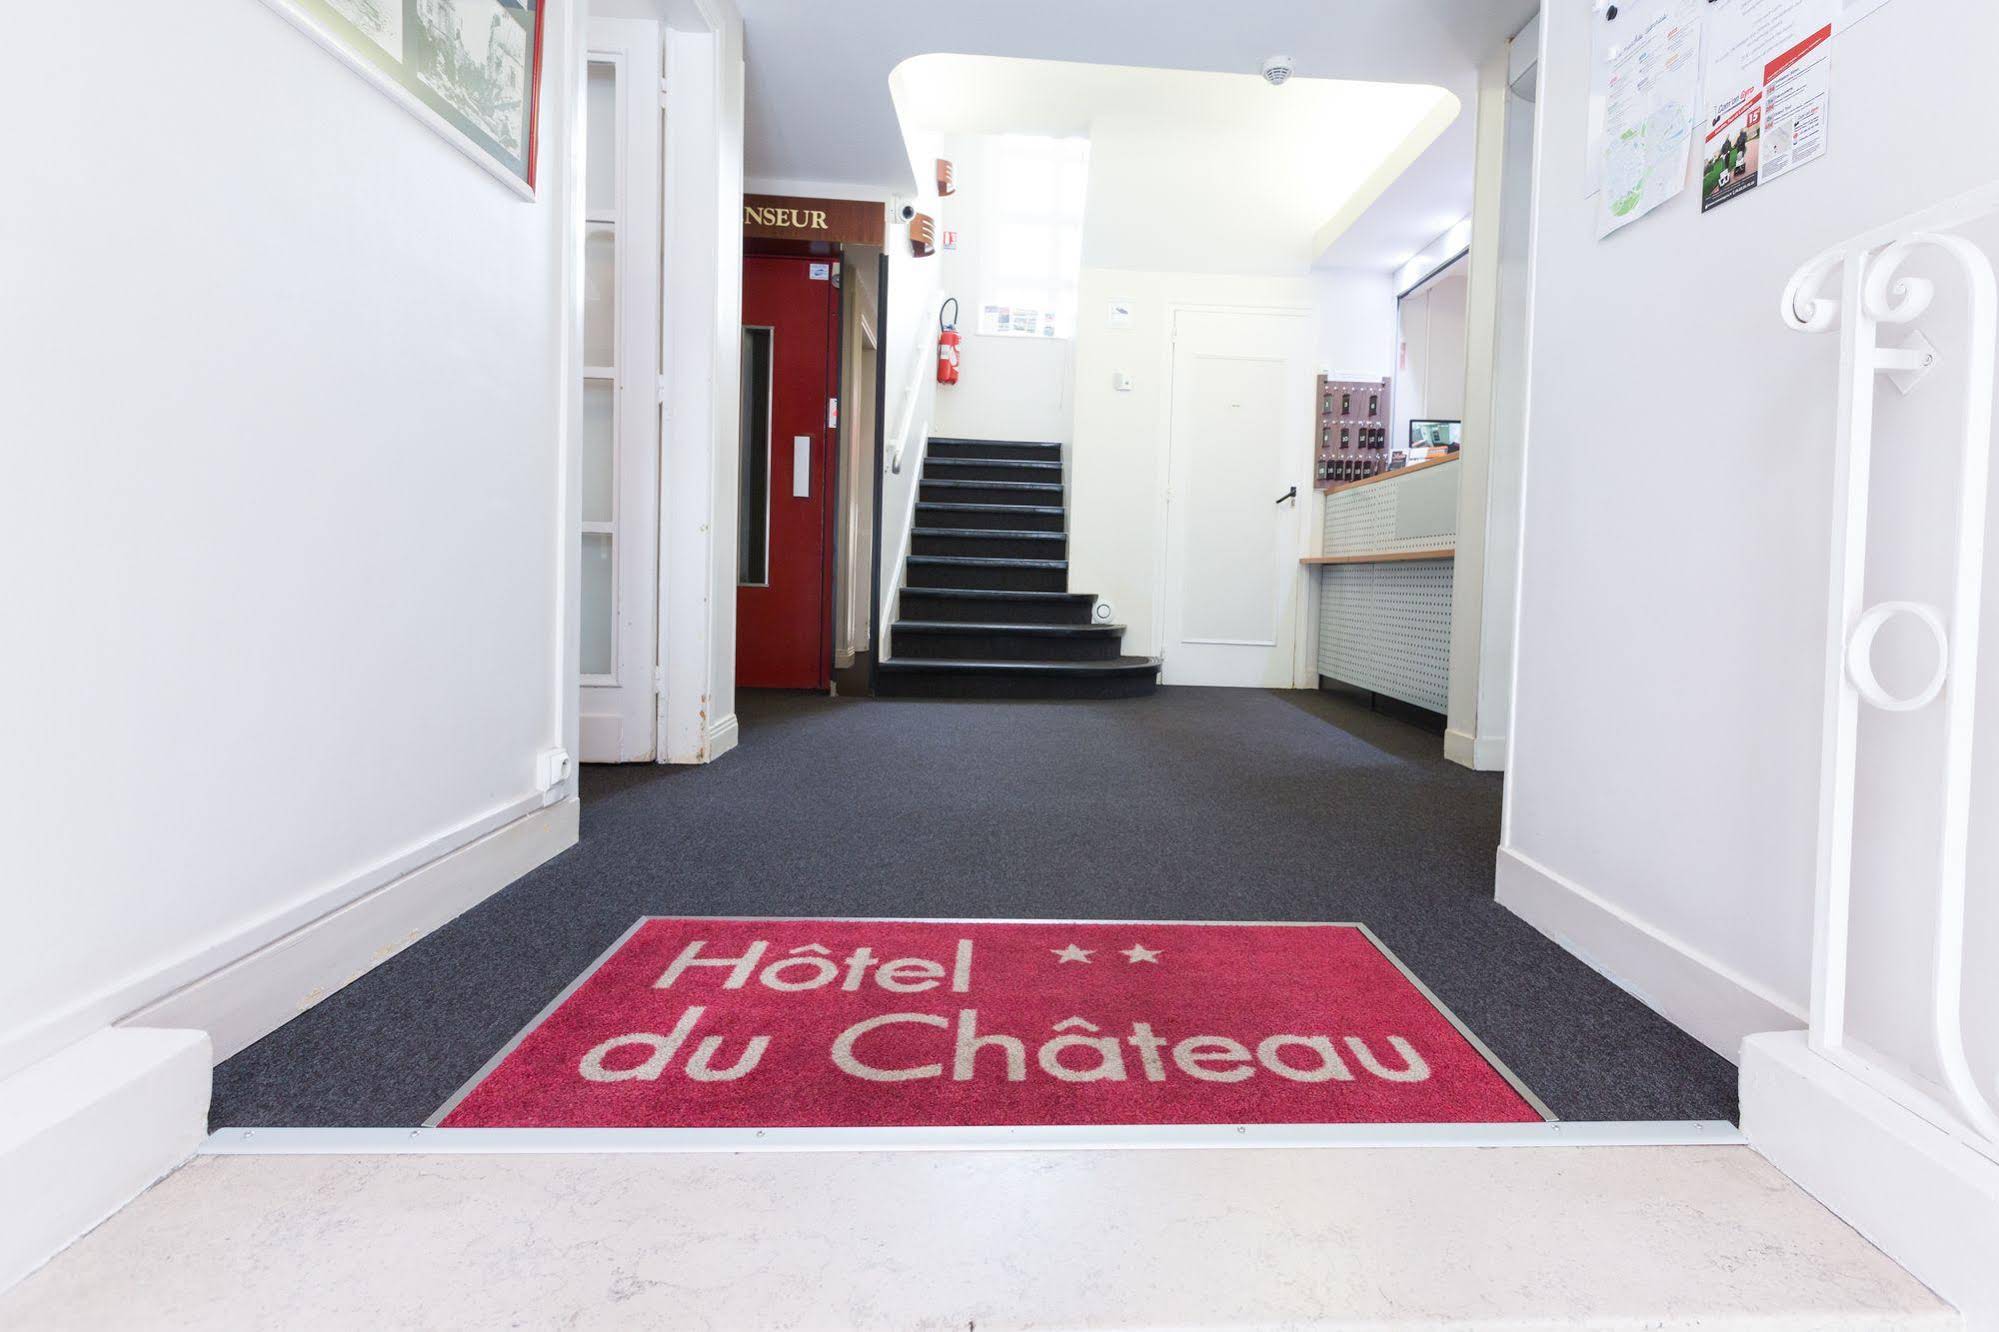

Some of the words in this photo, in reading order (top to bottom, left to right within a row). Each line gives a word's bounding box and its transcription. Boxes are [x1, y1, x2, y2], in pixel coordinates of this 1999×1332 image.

[744, 207, 828, 230] NSEUR
[654, 939, 973, 993] Hôtel
[579, 1006, 770, 1082] du
[831, 1009, 1430, 1082] Château
